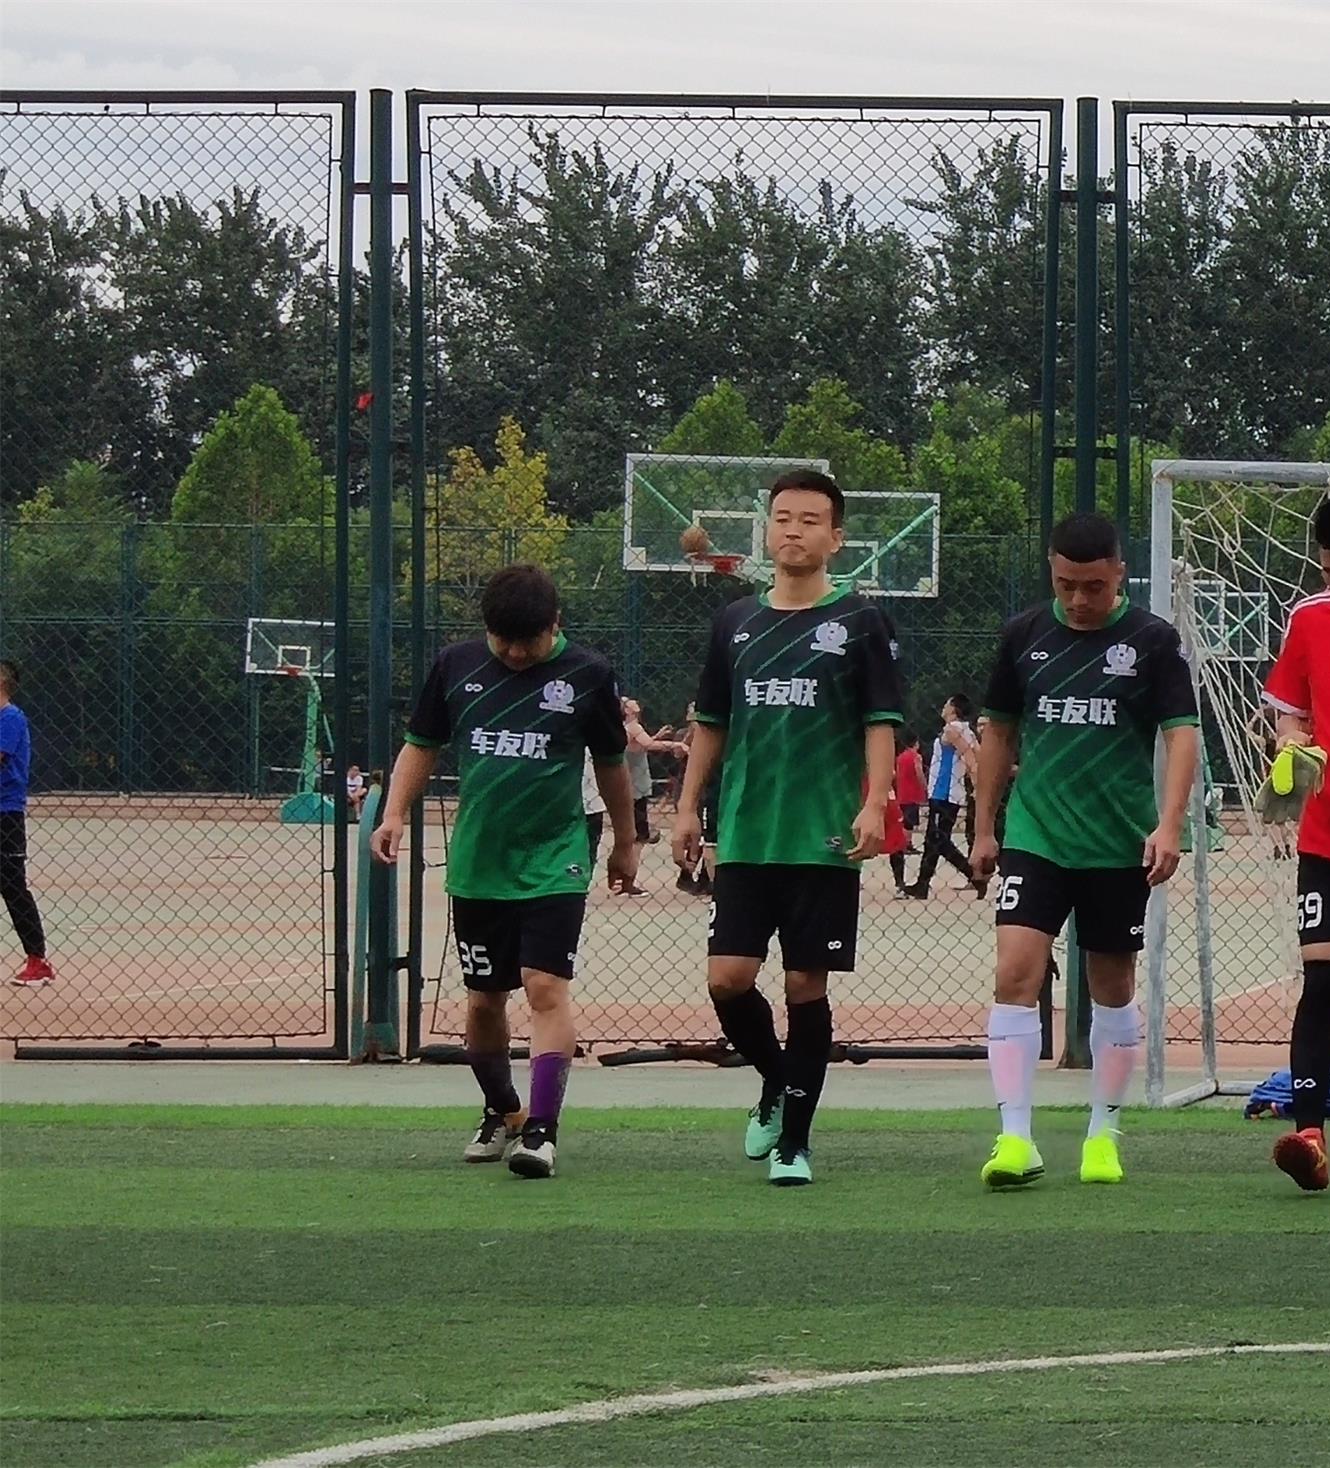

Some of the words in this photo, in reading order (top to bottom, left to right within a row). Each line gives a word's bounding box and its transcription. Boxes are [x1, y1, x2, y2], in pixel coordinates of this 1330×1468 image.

[744, 678, 818, 708] 车友联
[1037, 694, 1117, 726] 车友联
[470, 727, 552, 761] 车友联
[459, 940, 493, 976] 35
